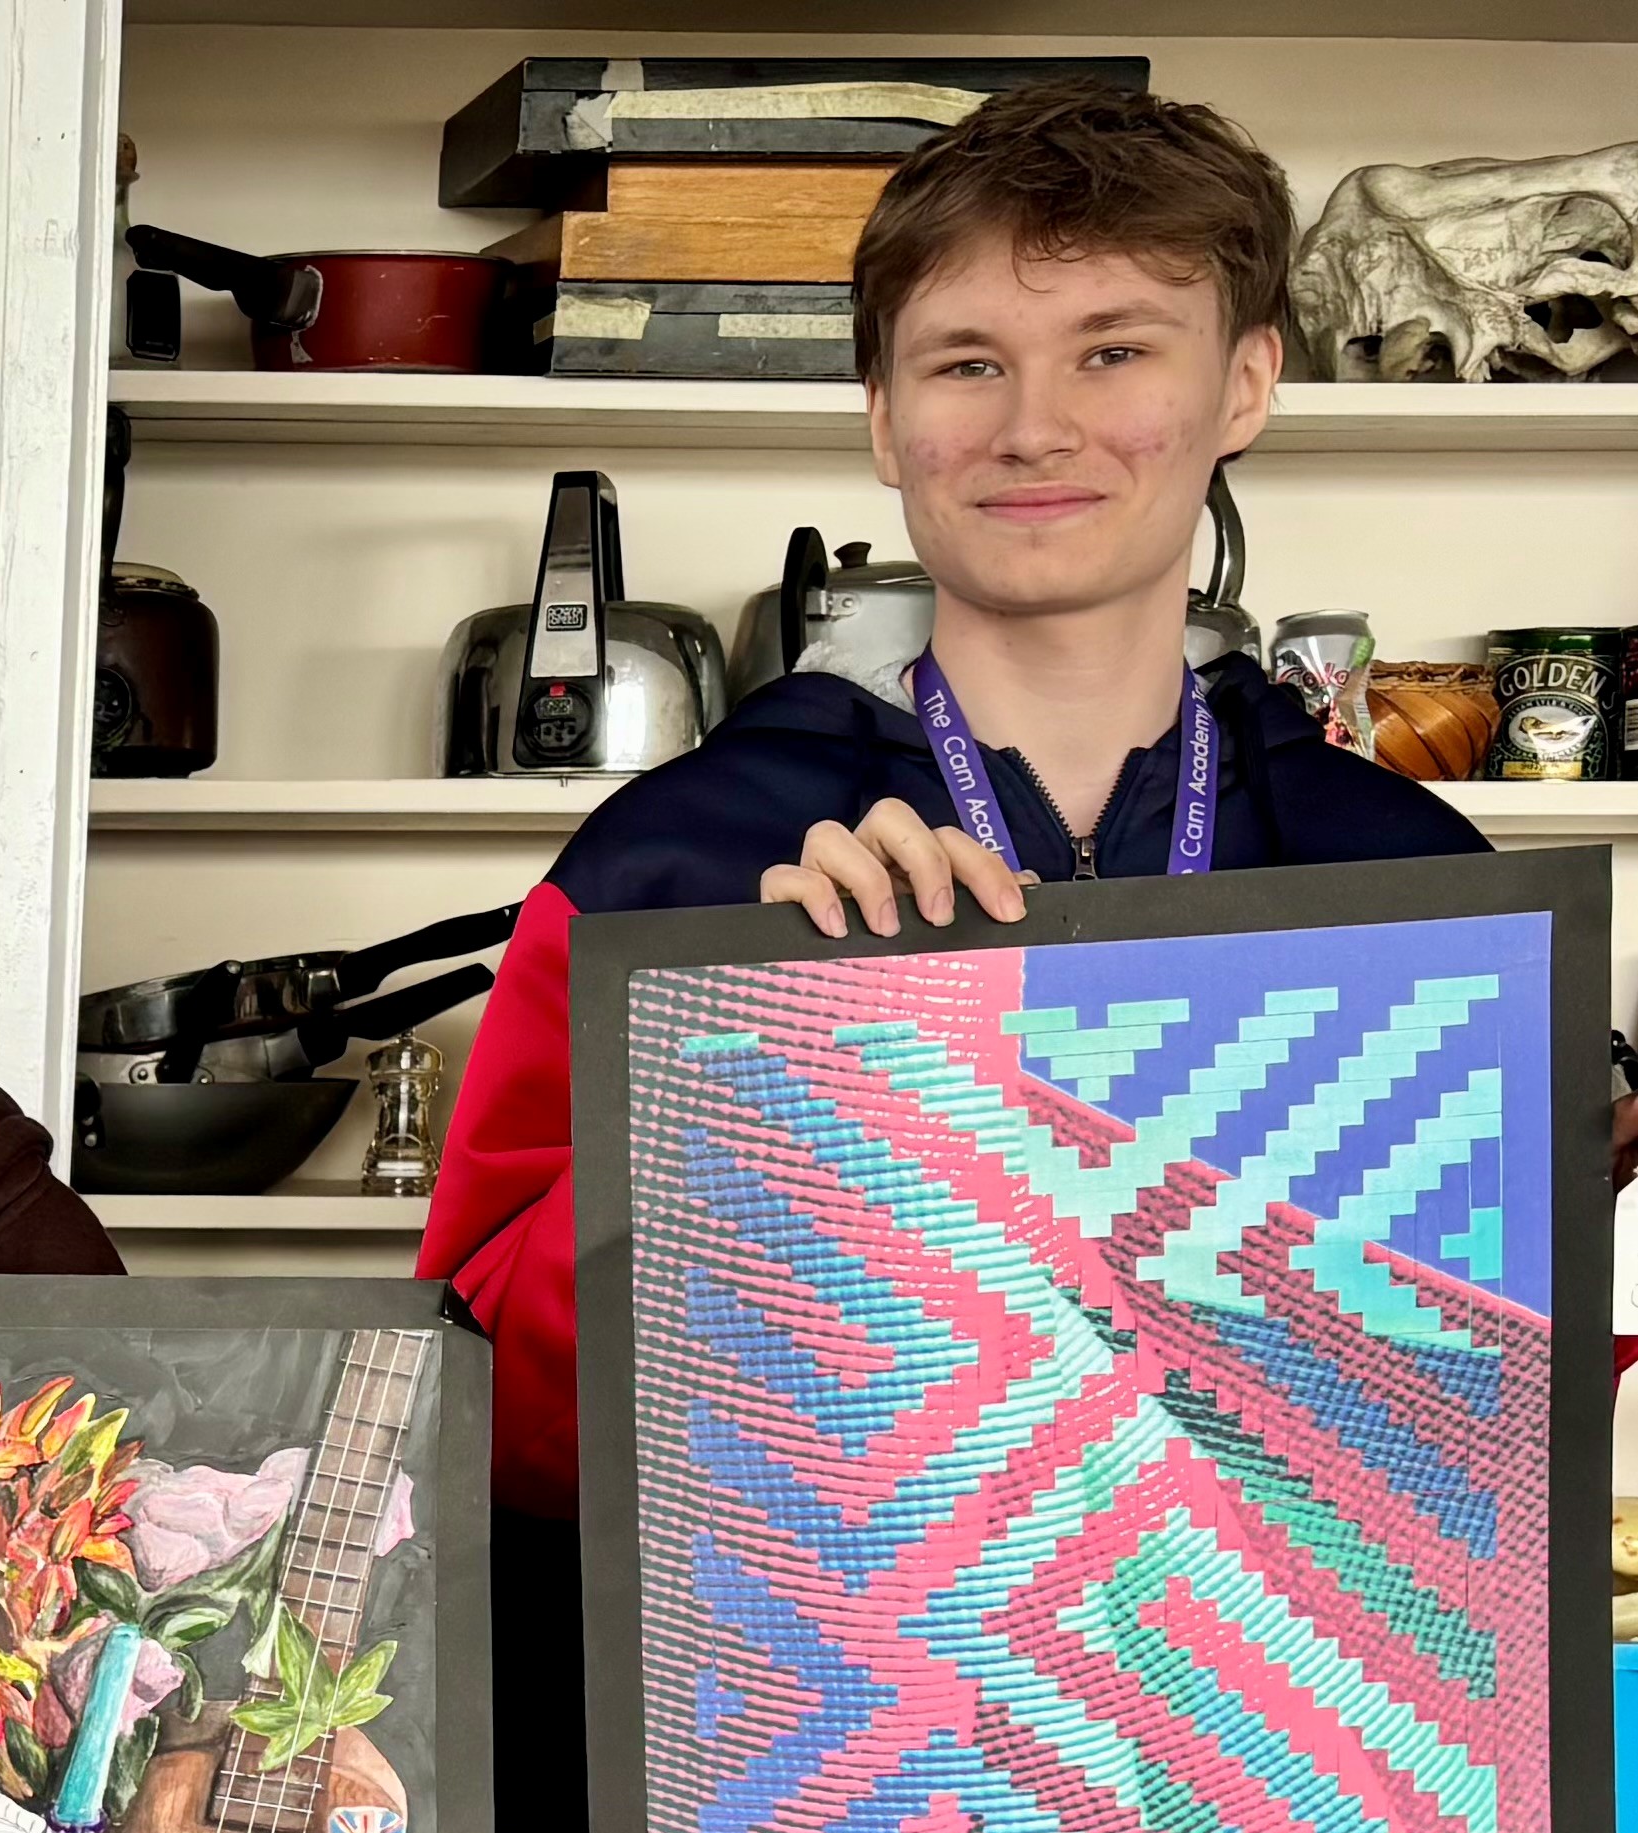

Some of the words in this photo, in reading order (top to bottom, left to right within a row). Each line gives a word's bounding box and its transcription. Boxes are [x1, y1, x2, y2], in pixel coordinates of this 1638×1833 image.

[1499, 662, 1607, 697] GOLDEN
[923, 689, 952, 728] The
[943, 736, 976, 791] Cam
[965, 798, 1006, 854] Acad
[1188, 703, 1213, 796] Academy
[1179, 801, 1206, 858] Cam
